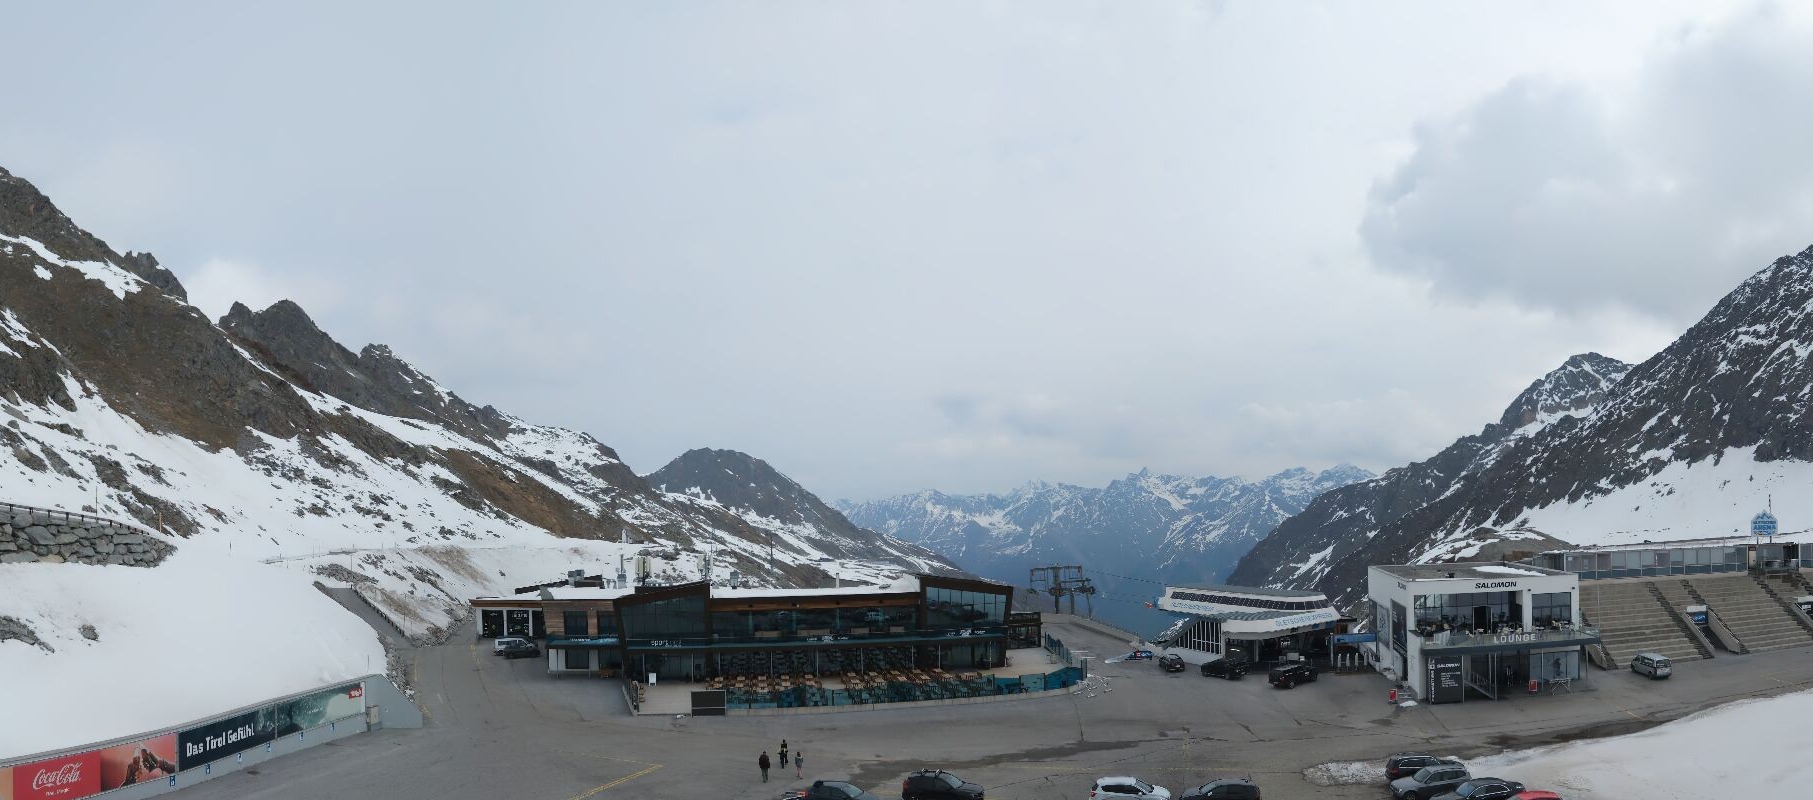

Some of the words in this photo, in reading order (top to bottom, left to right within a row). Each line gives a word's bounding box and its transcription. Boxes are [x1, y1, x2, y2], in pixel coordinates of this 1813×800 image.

[1474, 581, 1517, 590] SALOMON
[1493, 633, 1537, 644] LOUNGE
[186, 742, 204, 758] Das
[205, 731, 226, 751] Tirol
[227, 722, 255, 744] Gefühl
